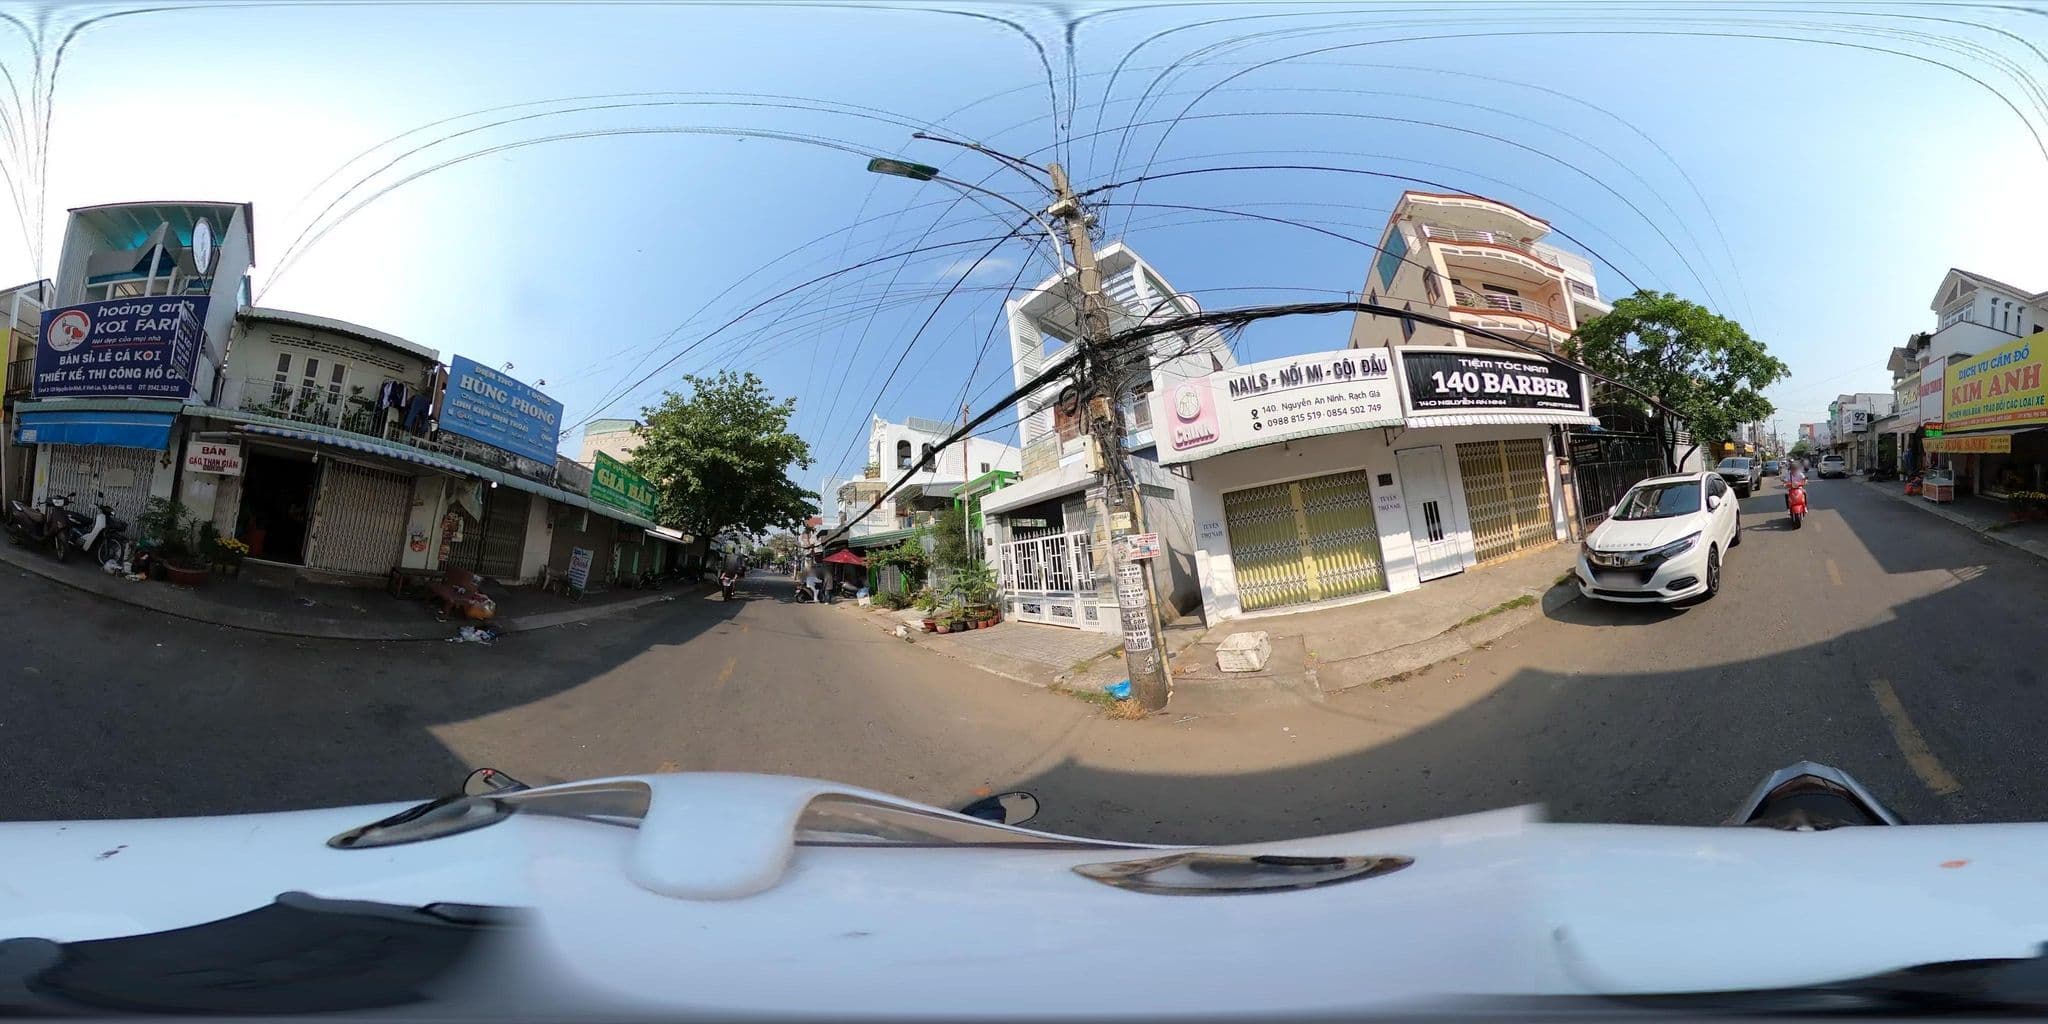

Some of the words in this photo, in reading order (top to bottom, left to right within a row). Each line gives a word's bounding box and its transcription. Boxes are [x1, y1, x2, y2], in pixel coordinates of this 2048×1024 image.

[97, 302, 153, 317] hoàng
[94, 319, 129, 335] KOI
[59, 351, 80, 366] BÁN
[115, 349, 131, 361] CÁ
[133, 350, 161, 361] KOI
[1458, 358, 1493, 370] TIỆM
[1495, 360, 1522, 371] TÓC
[1523, 364, 1549, 374] NAM
[1958, 365, 1976, 380] DỊCH
[1978, 360, 1989, 373] VỤ
[1990, 352, 2012, 369] CẦM
[2013, 342, 2030, 362] ĐỒ
[39, 367, 67, 383] THIẾT
[68, 366, 86, 381] KẾ,
[88, 369, 106, 380] THI
[108, 366, 142, 379] CÔNG
[145, 364, 163, 379] HỒ
[1228, 372, 1269, 398] NAILS
[1279, 362, 1303, 388] NỐI
[1306, 364, 1324, 383] MI
[1333, 357, 1357, 382] GỘI
[1361, 353, 1388, 377] ĐẦU
[1432, 371, 1479, 394] 140
[1481, 372, 1571, 399] BARBER
[1951, 380, 1983, 407] KIM
[1987, 362, 2043, 398] ANH
[460, 374, 508, 405] HÙNG
[511, 395, 555, 426] PHONG
[1314, 397, 1326, 406] An
[1348, 390, 1367, 400] Rạch
[2035, 395, 2045, 407] XE
[1267, 416, 1289, 427] 0988
[1290, 413, 1306, 423] 815
[1306, 411, 1322, 421] 519
[1326, 408, 1348, 418] 0854
[1350, 405, 1366, 415] 502
[1367, 403, 1382, 413] 749
[1854, 412, 1865, 421] 92
[202, 445, 227, 456] BÁN
[597, 467, 625, 495] GIA
